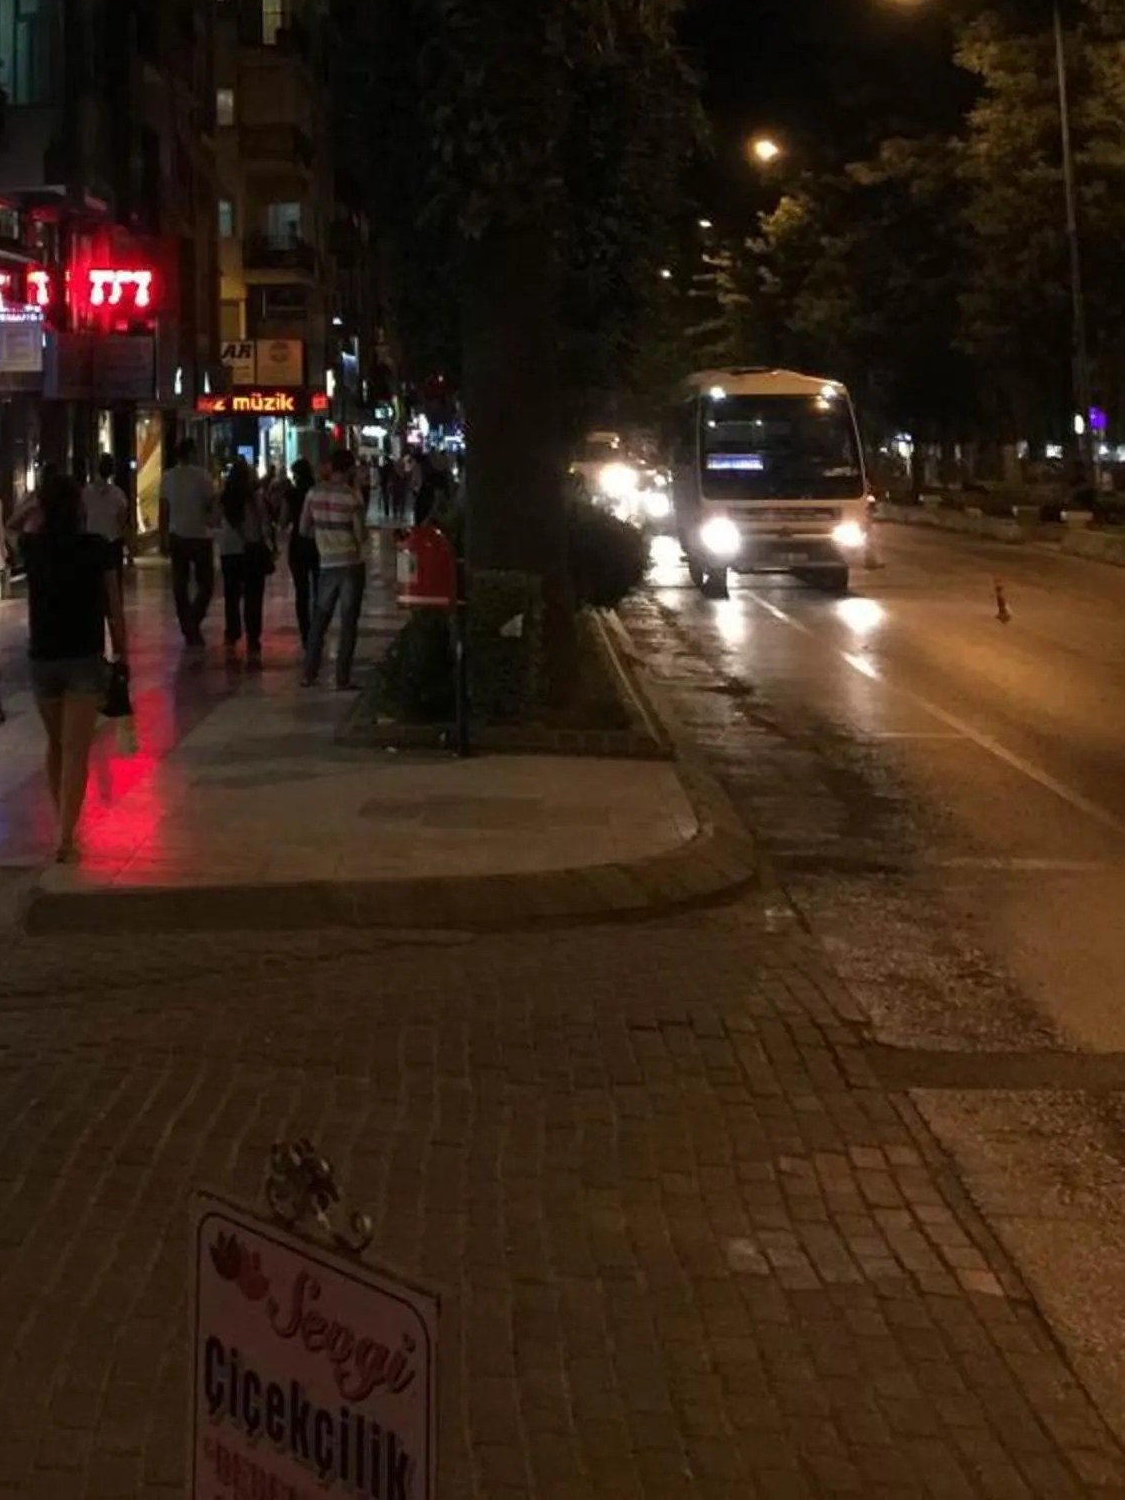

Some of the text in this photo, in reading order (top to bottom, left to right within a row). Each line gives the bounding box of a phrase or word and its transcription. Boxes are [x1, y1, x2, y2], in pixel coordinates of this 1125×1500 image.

[231, 390, 296, 412] müzik
[266, 1269, 417, 1402] Sevgi
[204, 1335, 417, 1500] Çiçekçilik
